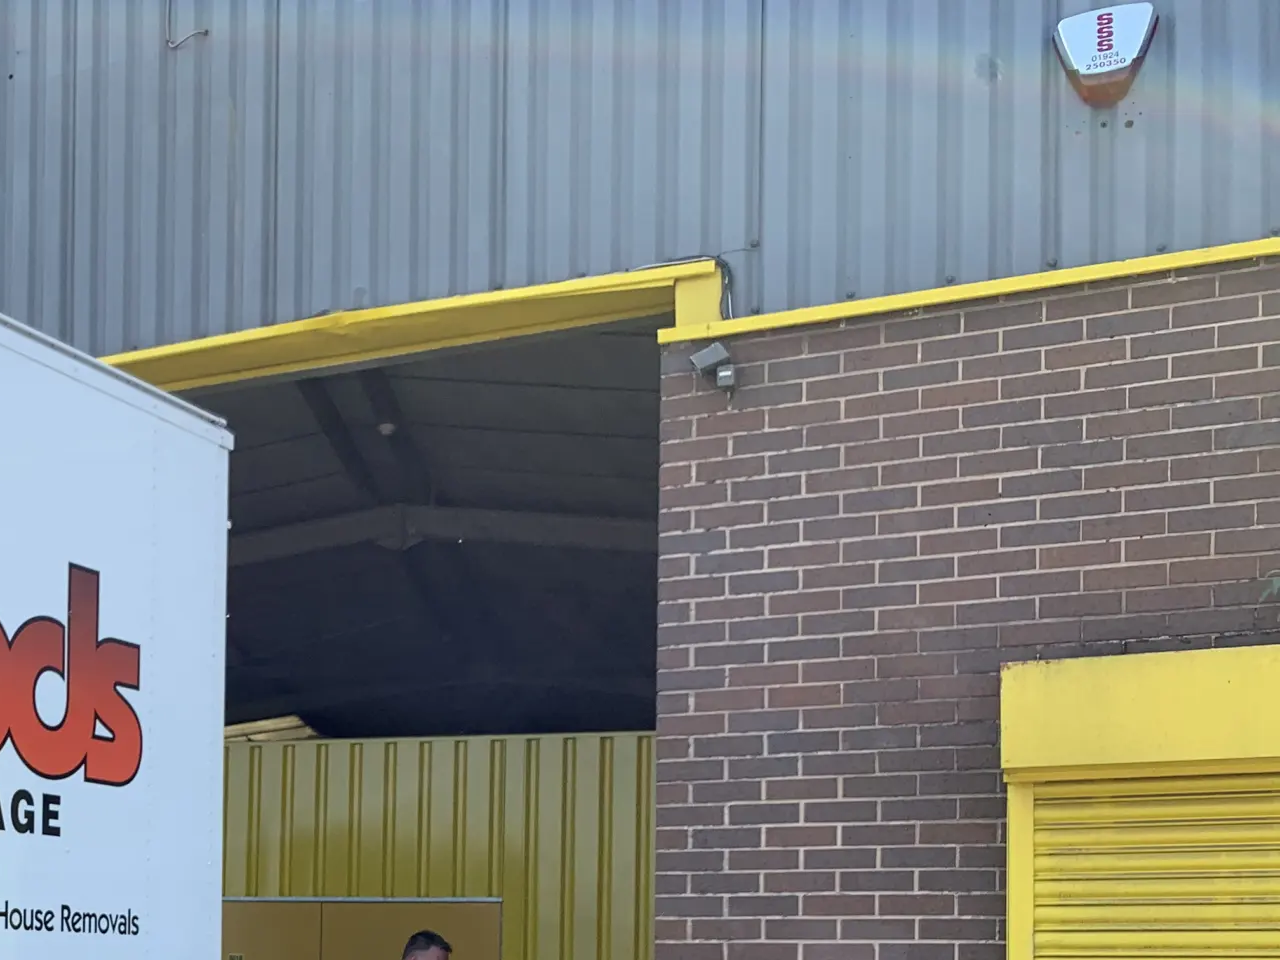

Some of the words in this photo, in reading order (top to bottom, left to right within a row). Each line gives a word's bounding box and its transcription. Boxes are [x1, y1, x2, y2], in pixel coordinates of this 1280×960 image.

[1091, 51, 1119, 62] 01924
[1085, 57, 1126, 70] 250350
[61, 904, 140, 937] Removals
